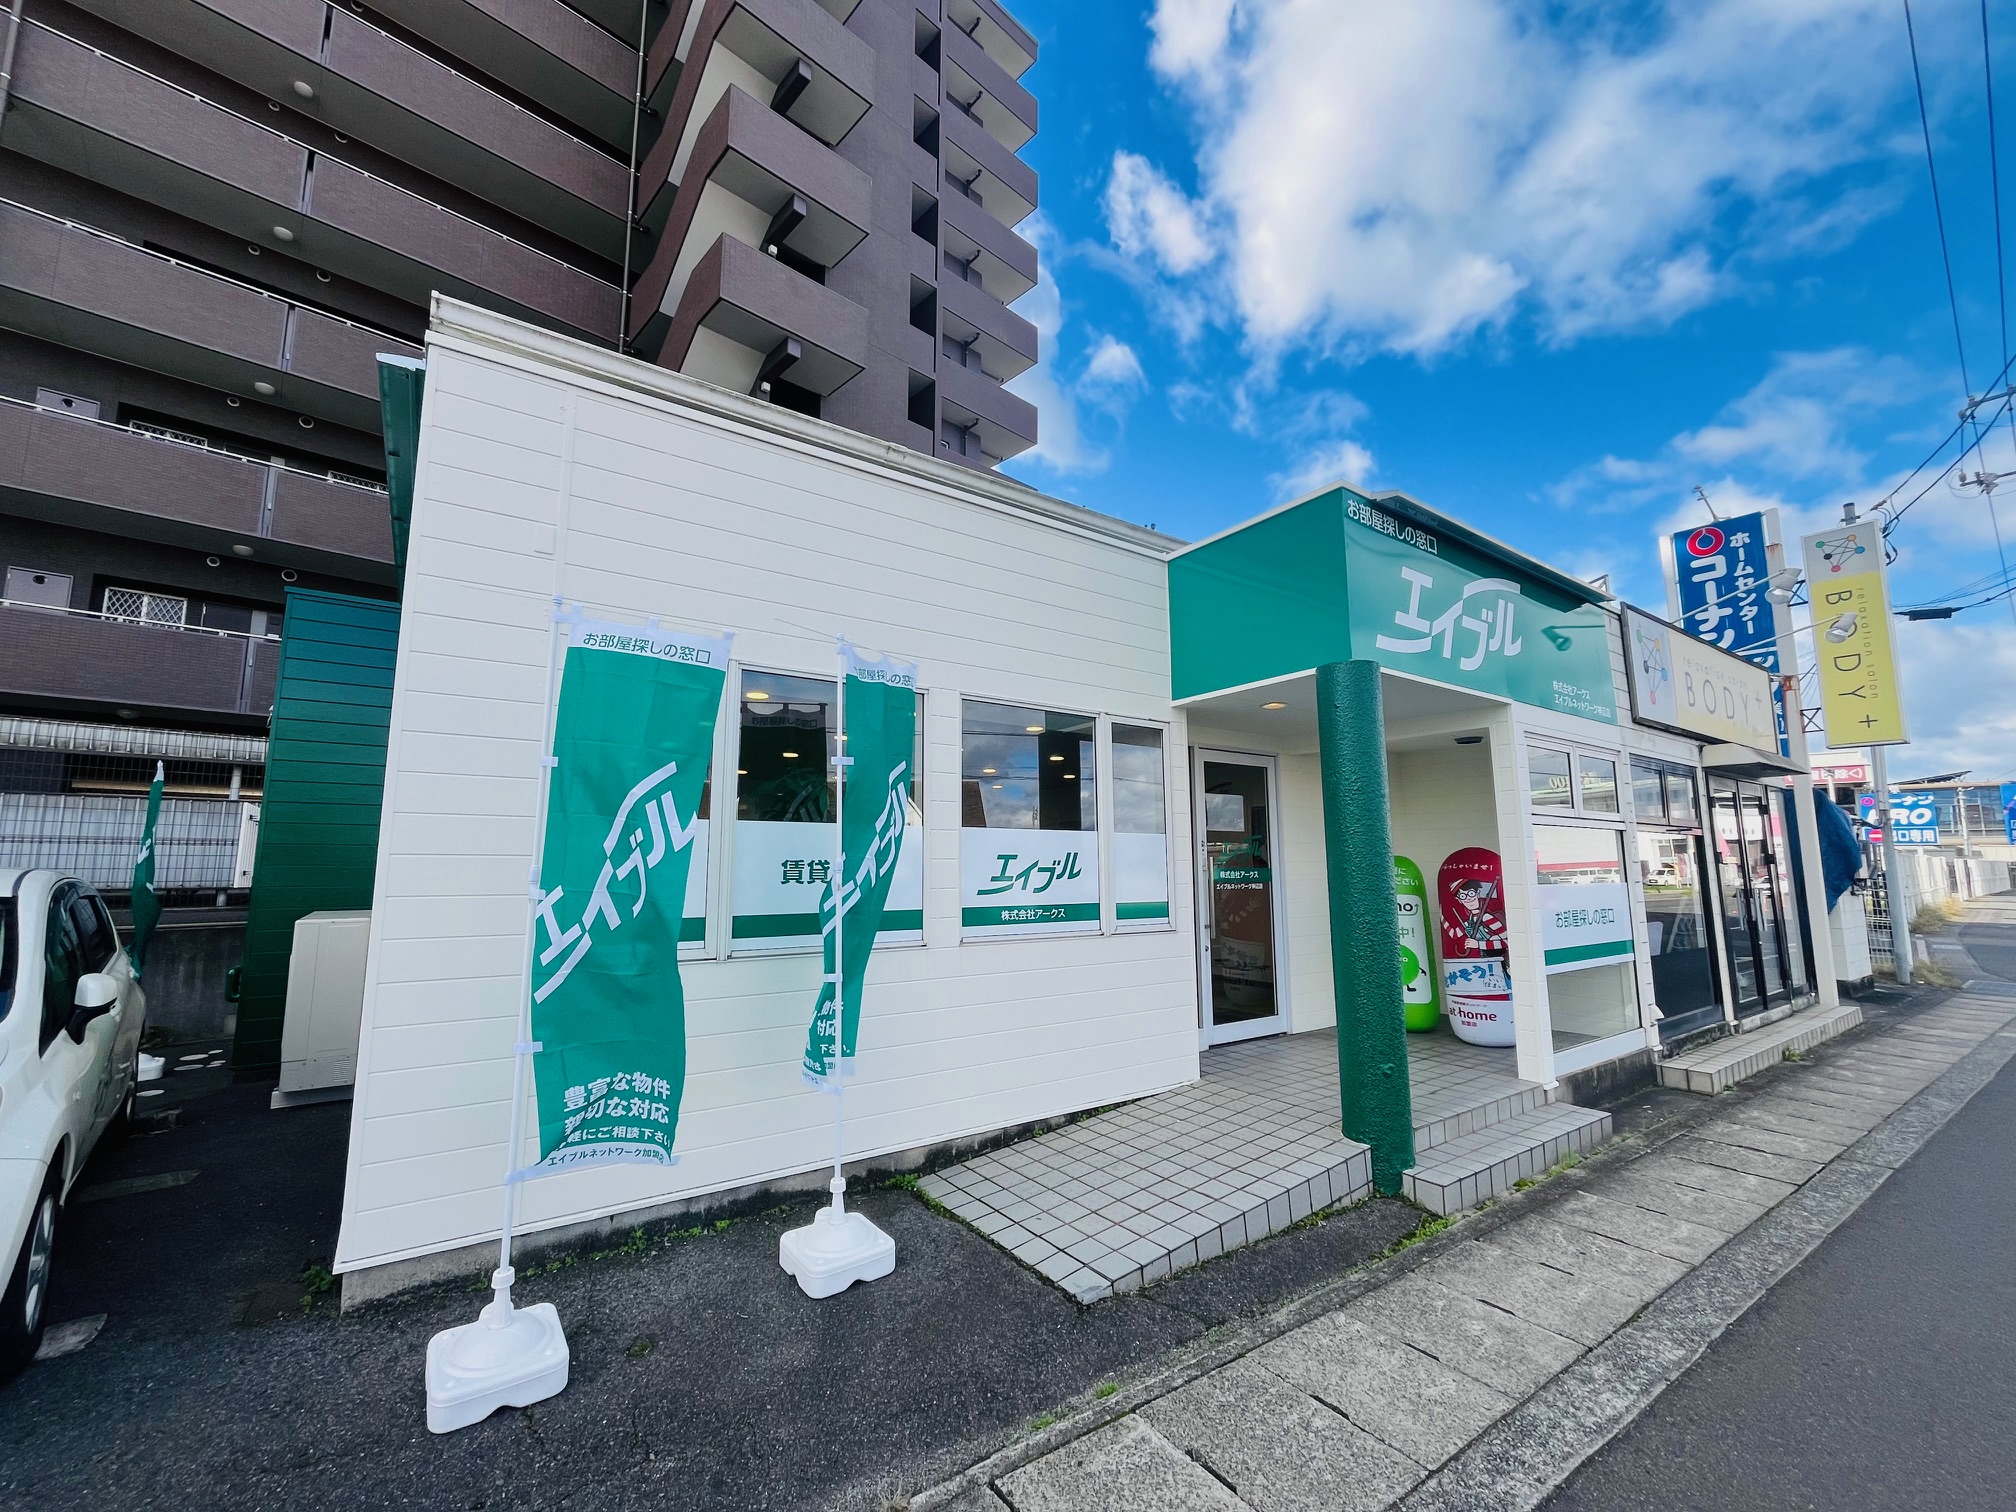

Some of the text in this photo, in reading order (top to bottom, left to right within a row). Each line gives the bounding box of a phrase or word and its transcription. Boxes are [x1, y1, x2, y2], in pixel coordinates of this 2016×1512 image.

[1347, 499, 1438, 555] お部屋探しの窓口
[1729, 532, 1758, 635] ホームセンター
[1376, 566, 1522, 671] エイブル
[1690, 555, 1735, 649] コーナン
[583, 633, 711, 664] お部屋探しの窓口
[1856, 587, 1878, 699] relaxation salon
[854, 666, 914, 687] 部屋探しの窓
[1552, 680, 1591, 700] 株式会社アークス
[1889, 795, 1934, 806] ーナン
[533, 761, 697, 1004] エイブル
[977, 852, 1082, 895] エイブル
[1219, 871, 1259, 879] 株式会社アークス
[1001, 908, 1065, 921] 株式会社アークス
[1555, 908, 1615, 928] お部屋探しの窓口
[1458, 1006, 1498, 1022] home
[563, 1071, 671, 1113] 豊富な物件
